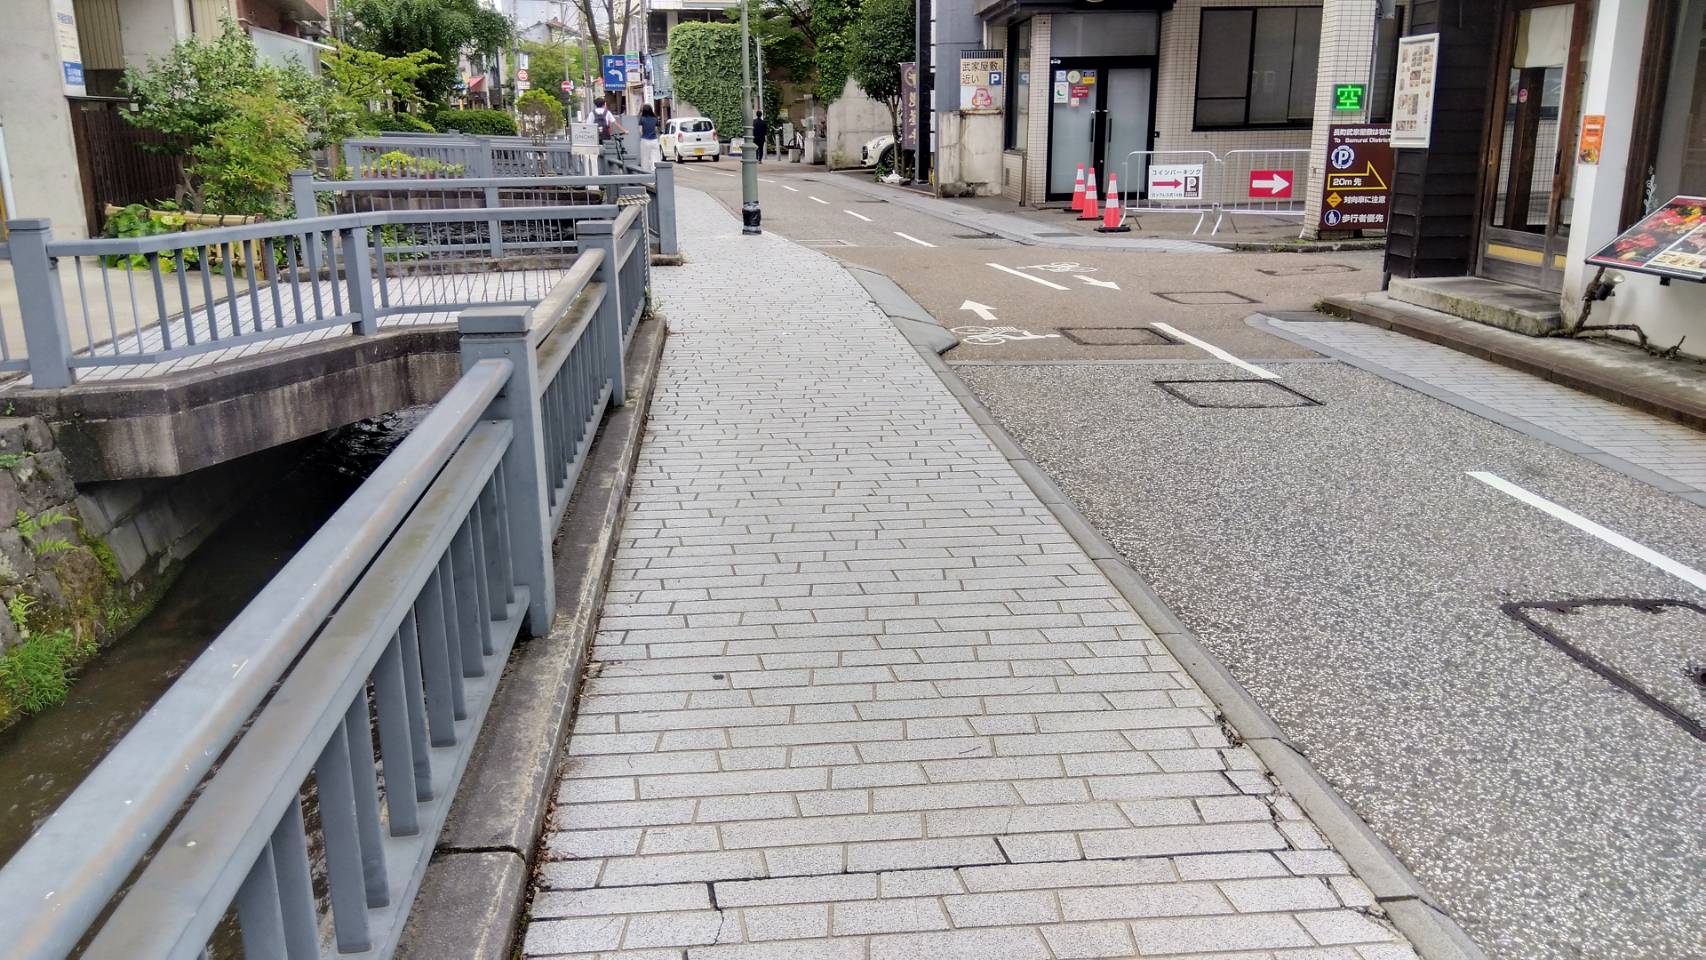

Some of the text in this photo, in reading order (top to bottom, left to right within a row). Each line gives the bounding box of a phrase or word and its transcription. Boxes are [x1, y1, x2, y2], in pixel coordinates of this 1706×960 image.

[962, 61, 999, 72] 武家屋敷
[962, 74, 980, 85] 近い
[990, 73, 1000, 84] P
[1336, 85, 1362, 109] 空
[1338, 150, 1349, 165] P
[1152, 168, 1201, 176] コインパーキング
[1333, 177, 1362, 186] 20m 先
[1342, 214, 1384, 223] 歩行者優先
